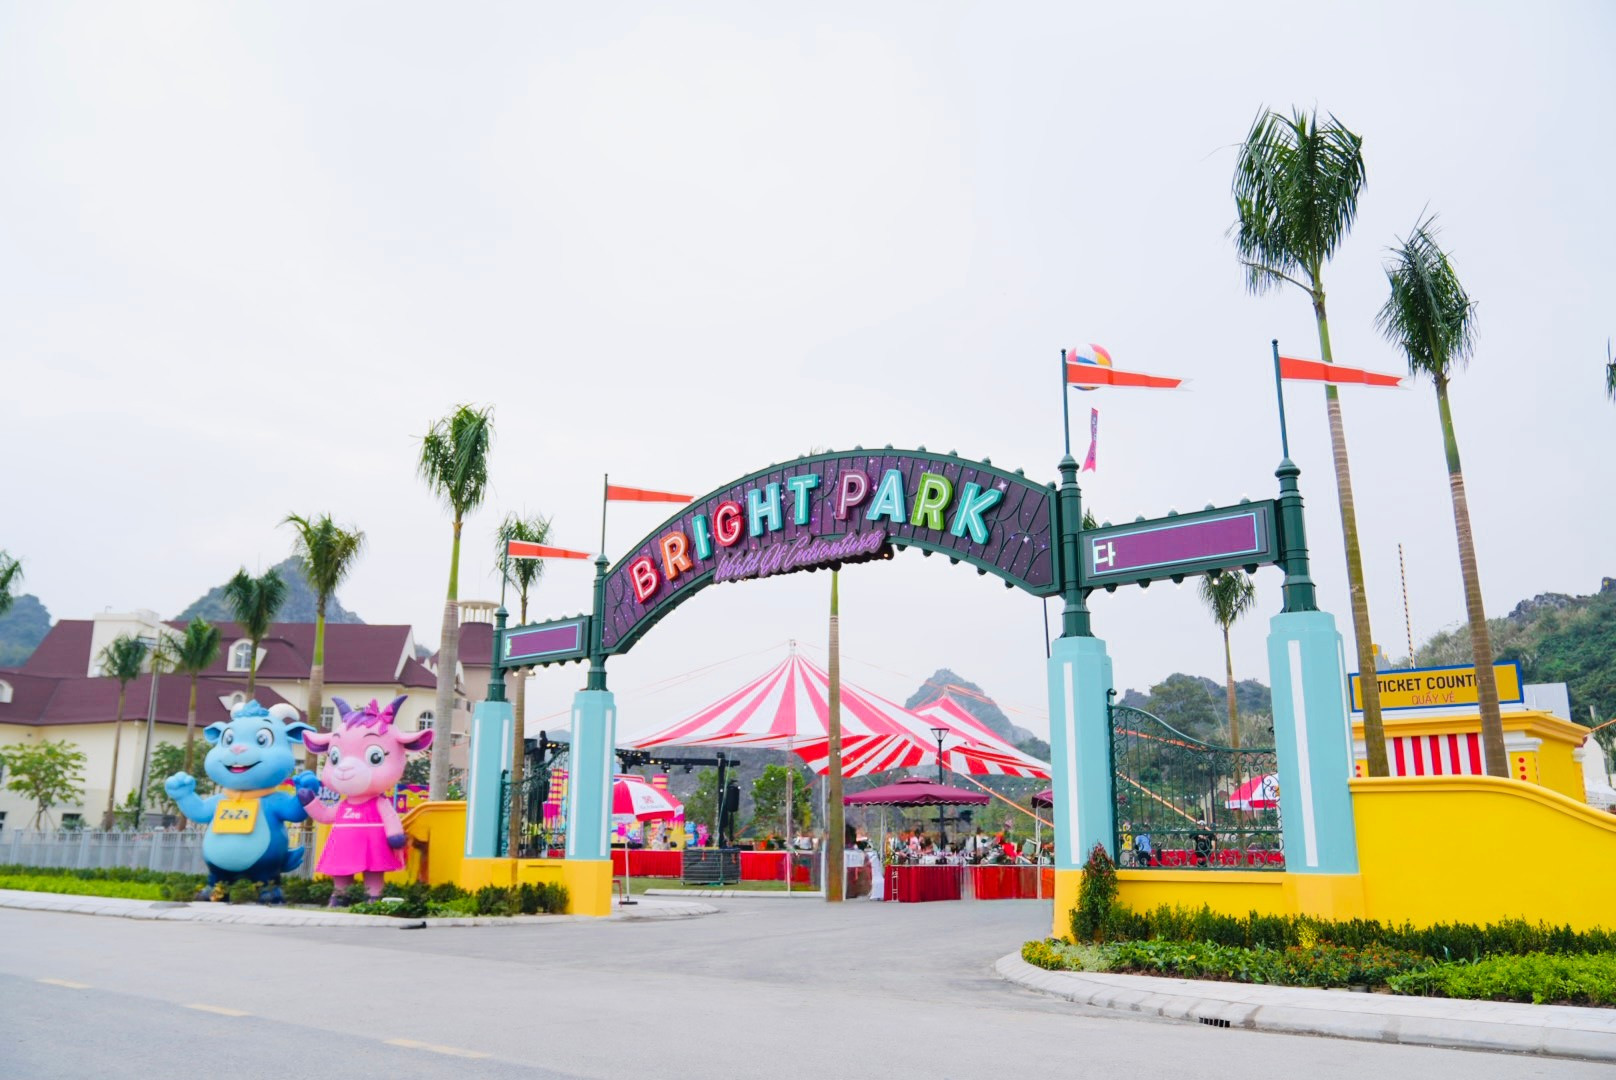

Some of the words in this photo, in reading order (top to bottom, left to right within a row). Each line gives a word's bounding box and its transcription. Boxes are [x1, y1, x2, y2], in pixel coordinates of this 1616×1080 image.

[629, 473, 818, 604] BRIGHT
[834, 468, 1003, 545] PARK
[715, 550, 763, 581] World
[1377, 678, 1421, 693] TICKET
[1426, 674, 1477, 690] COUNT
